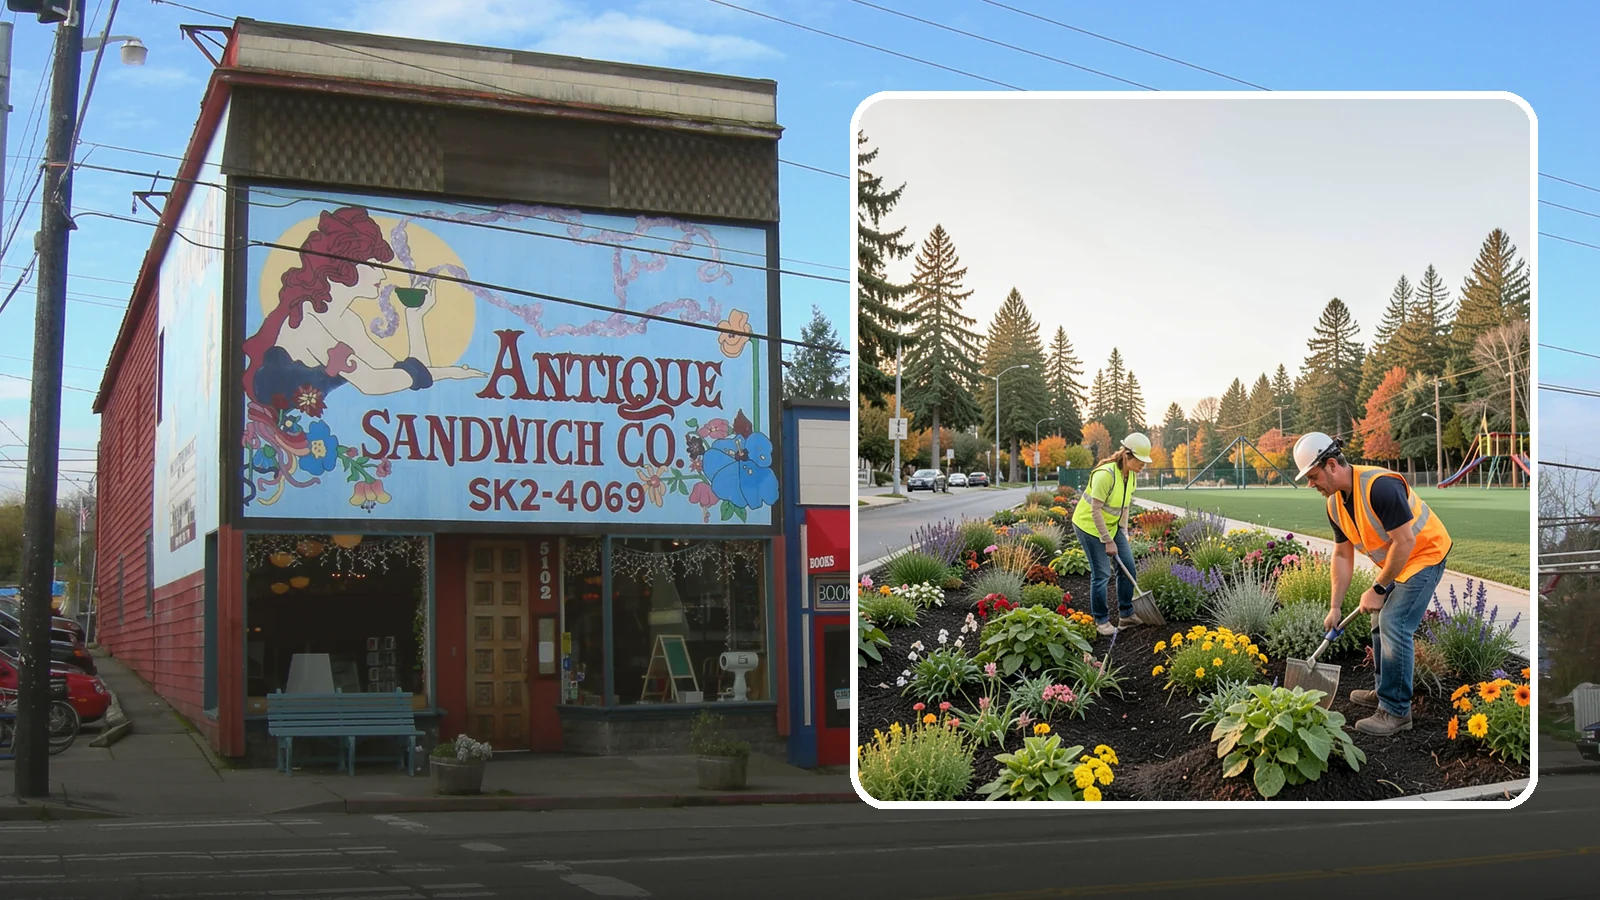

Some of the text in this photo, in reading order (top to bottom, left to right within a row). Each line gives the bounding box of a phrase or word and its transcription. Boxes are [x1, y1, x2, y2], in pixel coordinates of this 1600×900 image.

[476, 329, 723, 420] ANTIQUE
[361, 408, 685, 468] SANDWICH CO.
[468, 477, 646, 513] SK2-4069
[540, 541, 551, 600] 5102
[809, 555, 835, 569] BOOKS
